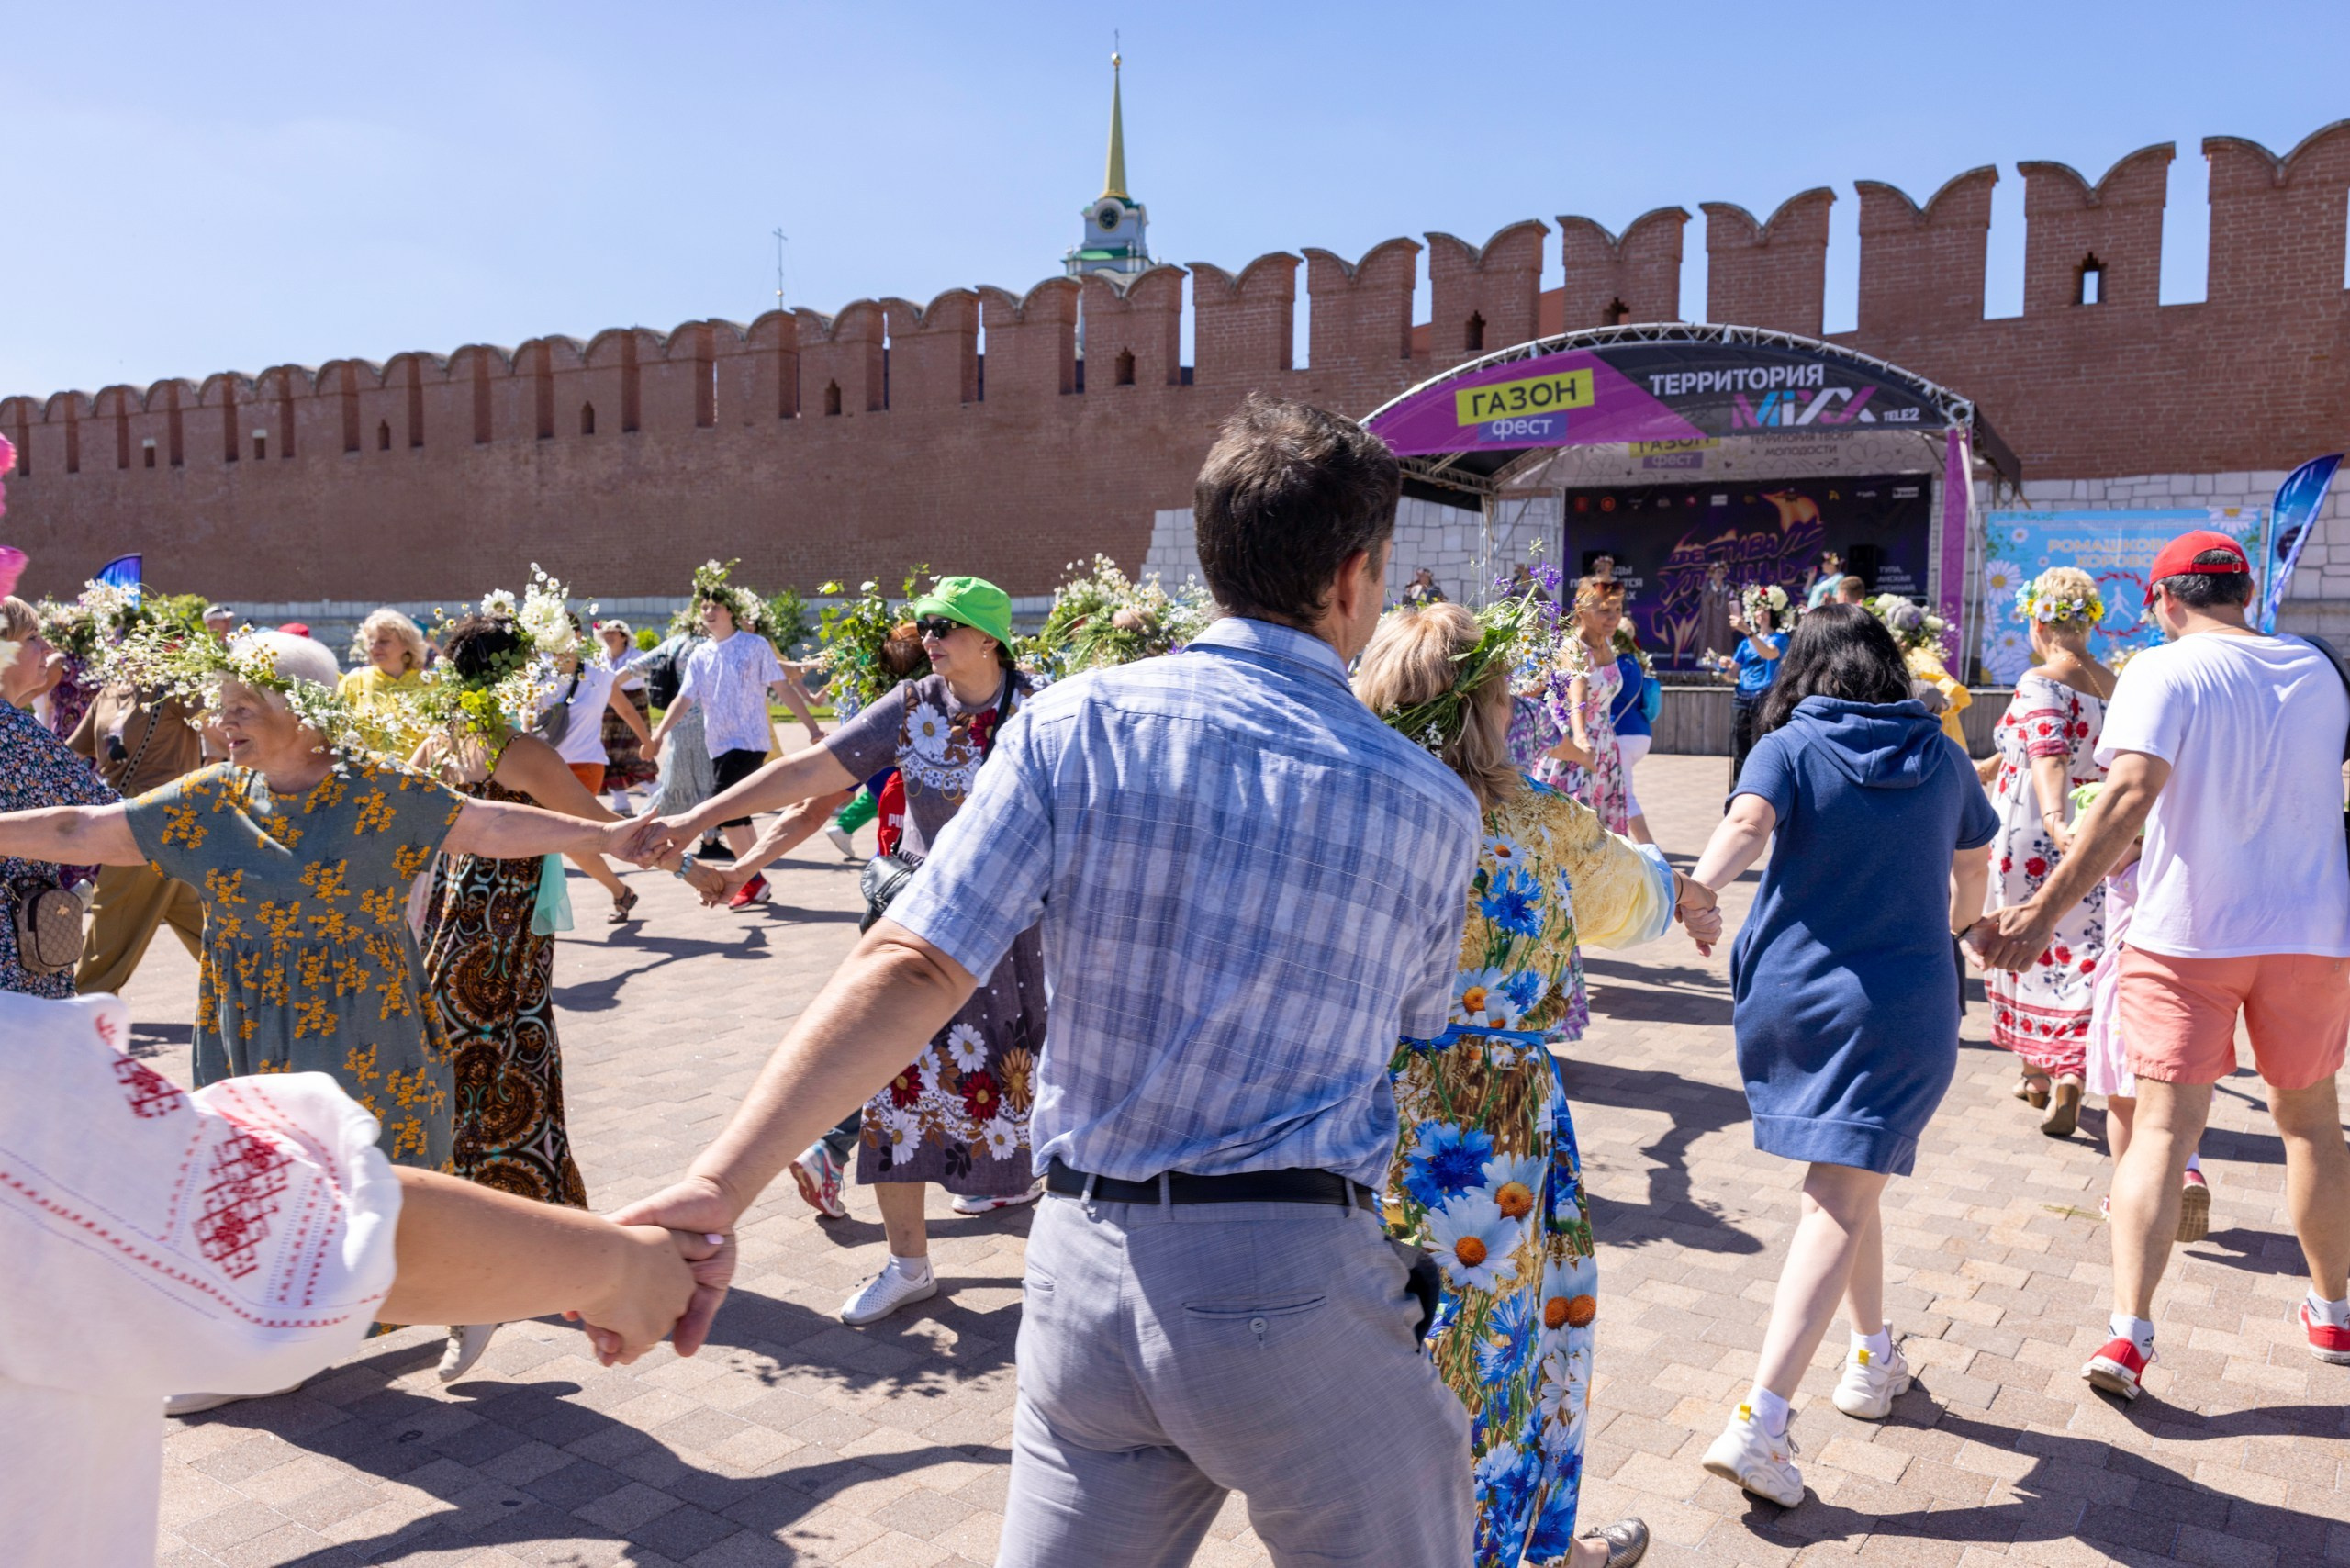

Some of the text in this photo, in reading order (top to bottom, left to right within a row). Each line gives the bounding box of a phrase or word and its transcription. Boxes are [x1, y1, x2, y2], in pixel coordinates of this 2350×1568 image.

[1649, 364, 1824, 396] ТЕРРИТОРИЯ
[1472, 377, 1577, 417] ГАЗОН
[1883, 408, 1919, 422] TELE2
[1491, 418, 1552, 441] фест
[1764, 444, 1838, 457] МОЛОДОСТИ
[1651, 454, 1694, 468] фест
[2047, 538, 2168, 553] РОМАШКОВ
[2075, 553, 2154, 567] ХОРОВО
[888, 812, 904, 828] PU
